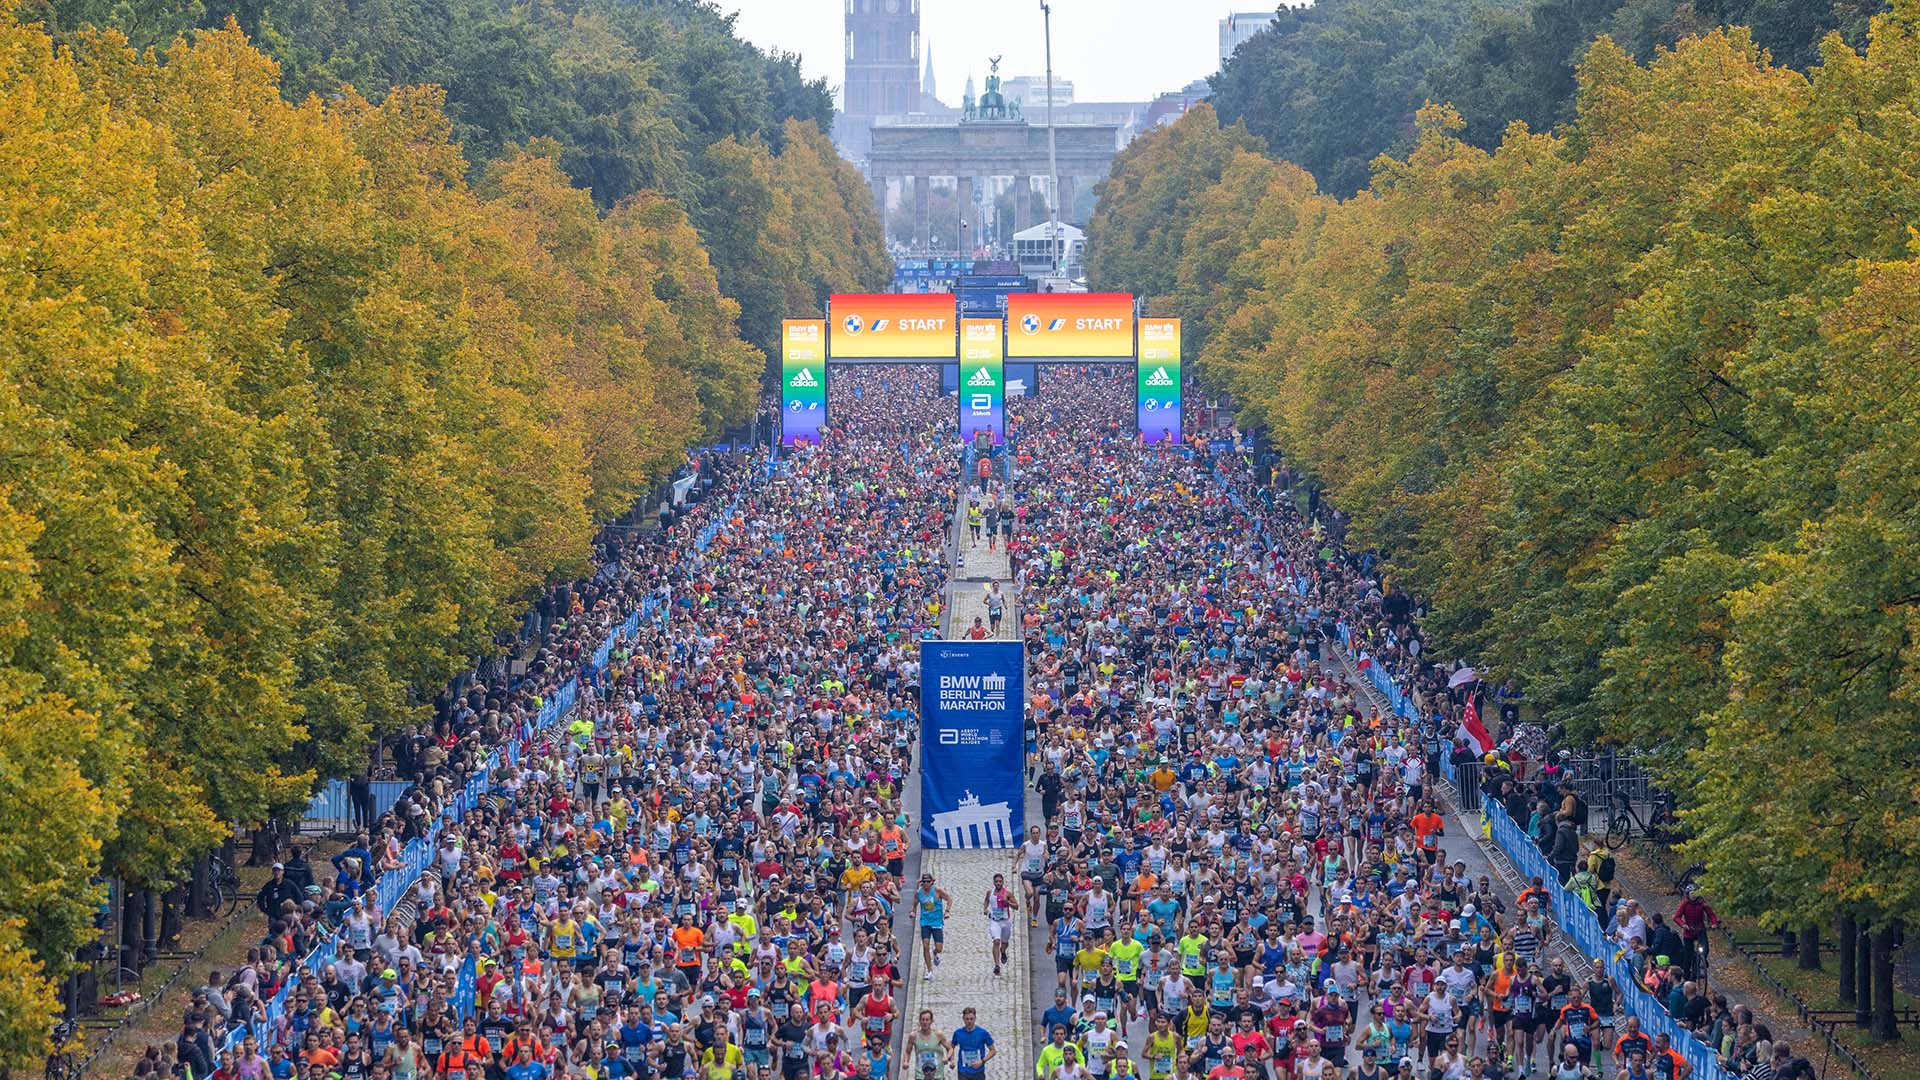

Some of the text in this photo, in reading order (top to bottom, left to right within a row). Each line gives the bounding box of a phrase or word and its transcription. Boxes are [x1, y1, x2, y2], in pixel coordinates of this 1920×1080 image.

[899, 319, 944, 331] START
[1076, 318, 1122, 330] START
[789, 379, 818, 387] adidas
[967, 378, 996, 386] adidas
[1145, 378, 1173, 386] adidas
[940, 676, 980, 689] BMW
[940, 690, 980, 699] BERLIN
[940, 701, 1005, 710] MARATHON
